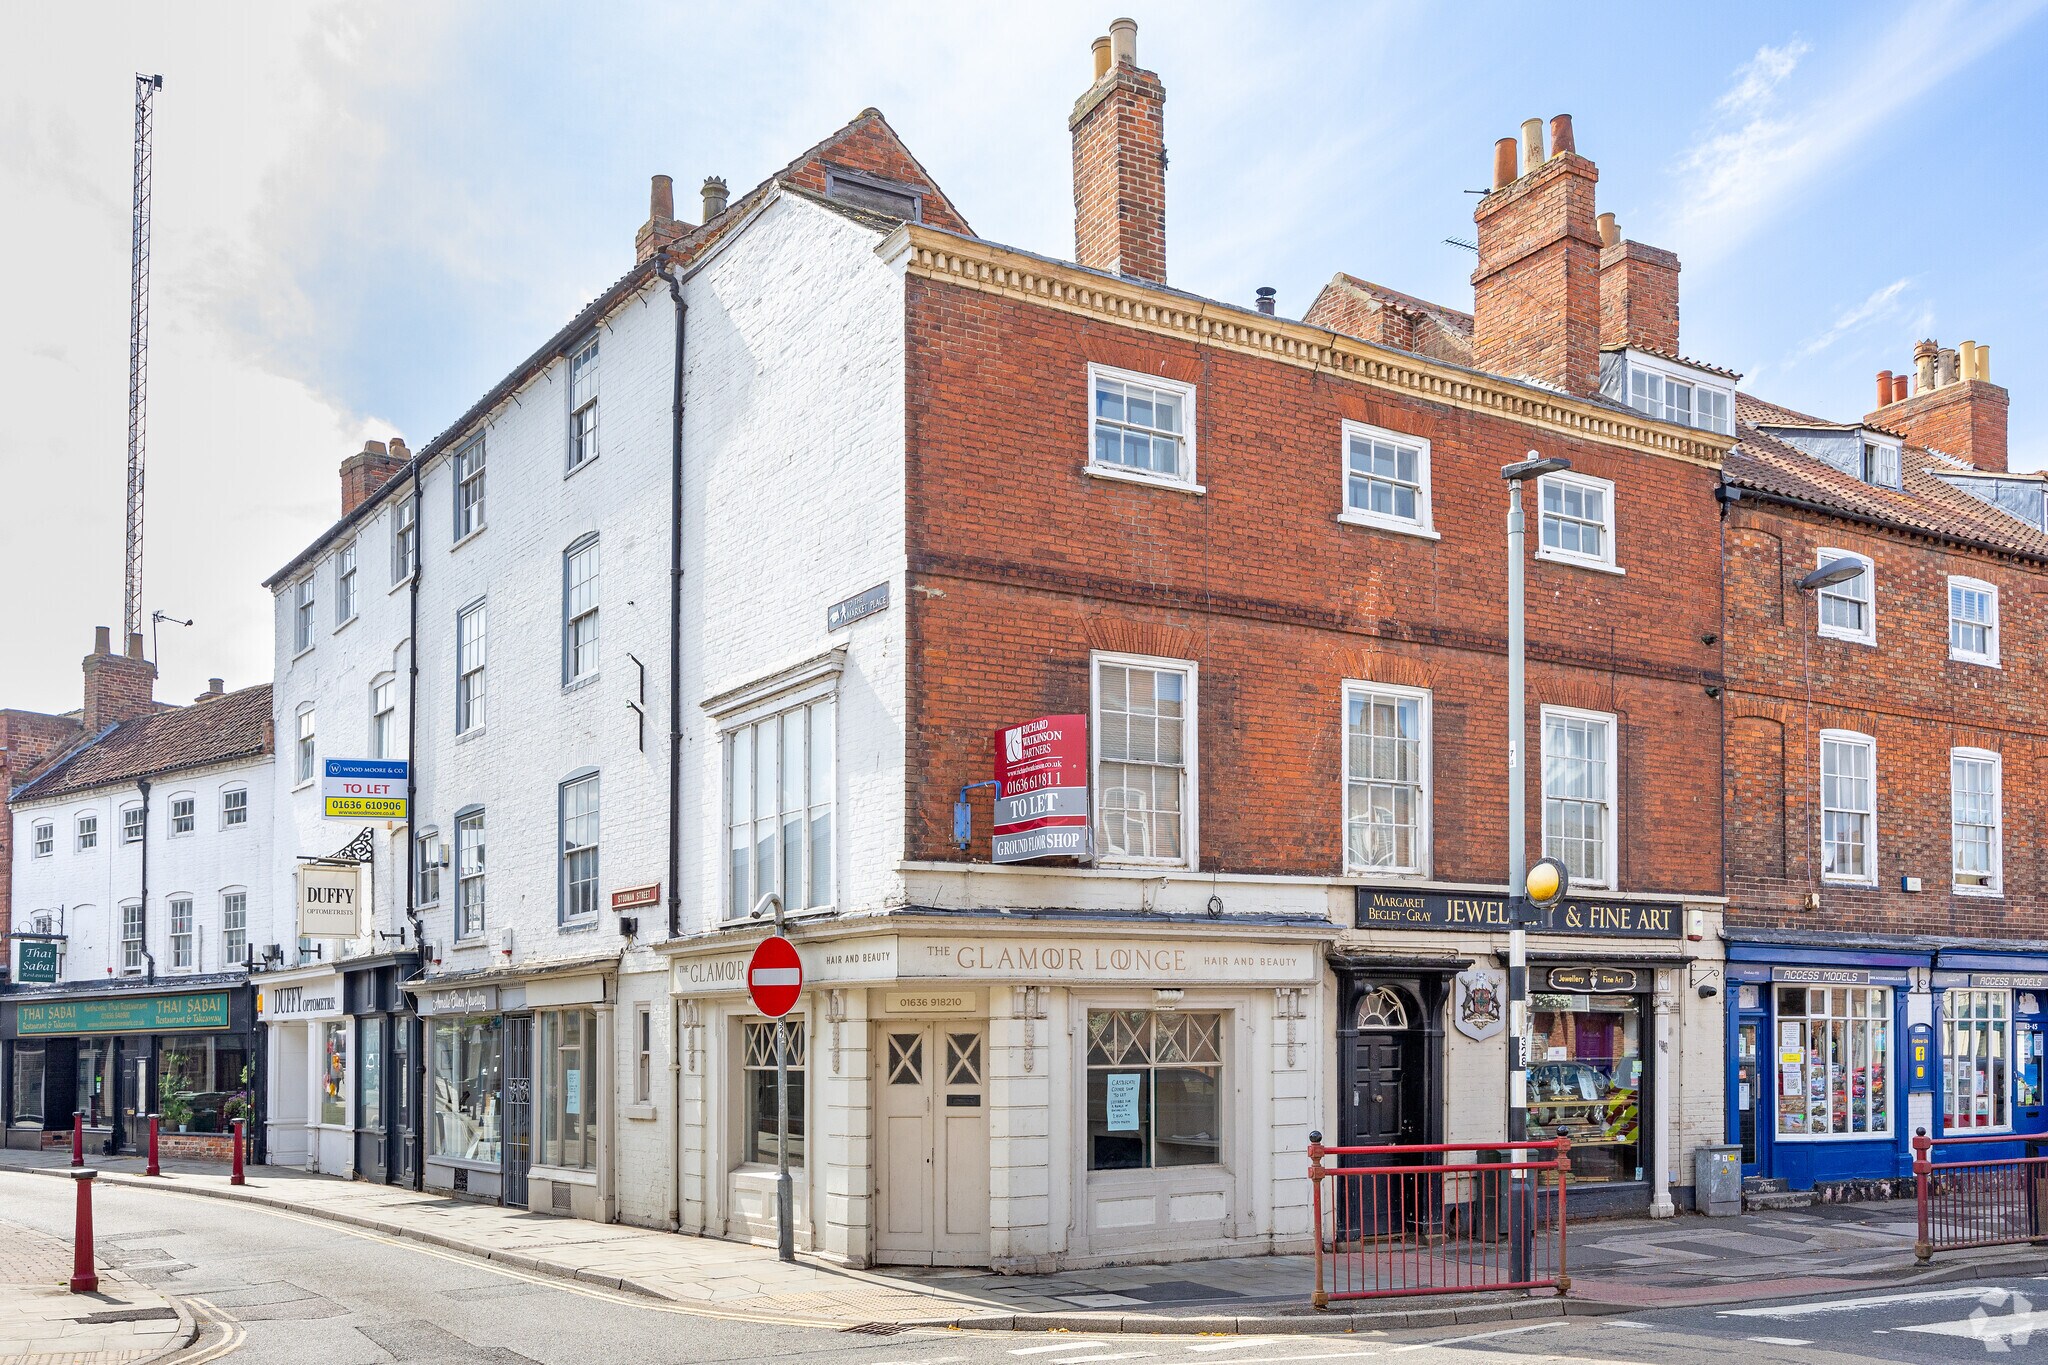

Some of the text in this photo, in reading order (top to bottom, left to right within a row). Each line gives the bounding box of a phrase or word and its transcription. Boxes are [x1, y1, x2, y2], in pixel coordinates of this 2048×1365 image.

[854, 596, 864, 605] THE
[846, 595, 887, 620] MARKET PLACE
[1022, 720, 1048, 735] RICHARD
[1022, 730, 1062, 746] WATKINSON
[1023, 743, 1051, 760] PARTNERS
[343, 784, 390, 794] TO LET
[1007, 776, 1028, 795] 01636
[332, 800, 401, 810] 01636 610906
[1010, 792, 1058, 818] TO LET
[997, 833, 1080, 856] GROUND FLOOR SHOP
[306, 887, 354, 904] DUFFY
[636, 890, 650, 900] STREET
[1566, 906, 1583, 928] &
[1590, 906, 1632, 930] FINE
[1637, 908, 1672, 930] ART
[26, 948, 52, 958] Thai
[826, 952, 890, 965] HAIR AND BEAUTY
[927, 946, 1186, 971] THE GLAMOUR LOUNGE
[22, 961, 54, 972] Sabai
[1204, 956, 1298, 967] HAIR AND BEAUTY
[679, 960, 745, 982] THE GLAMOUR
[1784, 970, 1858, 982] ACCESS MODELS
[1558, 975, 1584, 984] Jewellery
[1980, 977, 2042, 987] ACCESS MODELS
[156, 998, 220, 1014] THAI SABAI
[274, 986, 304, 1014] DUFFY
[898, 998, 962, 1007] 01636 918210
[23, 1006, 76, 1020] THAI SABAI
[156, 1013, 222, 1024] Restaurant & Takeaway
[23, 1022, 46, 1030] Restaurant
[53, 1020, 77, 1030] Takeaway
